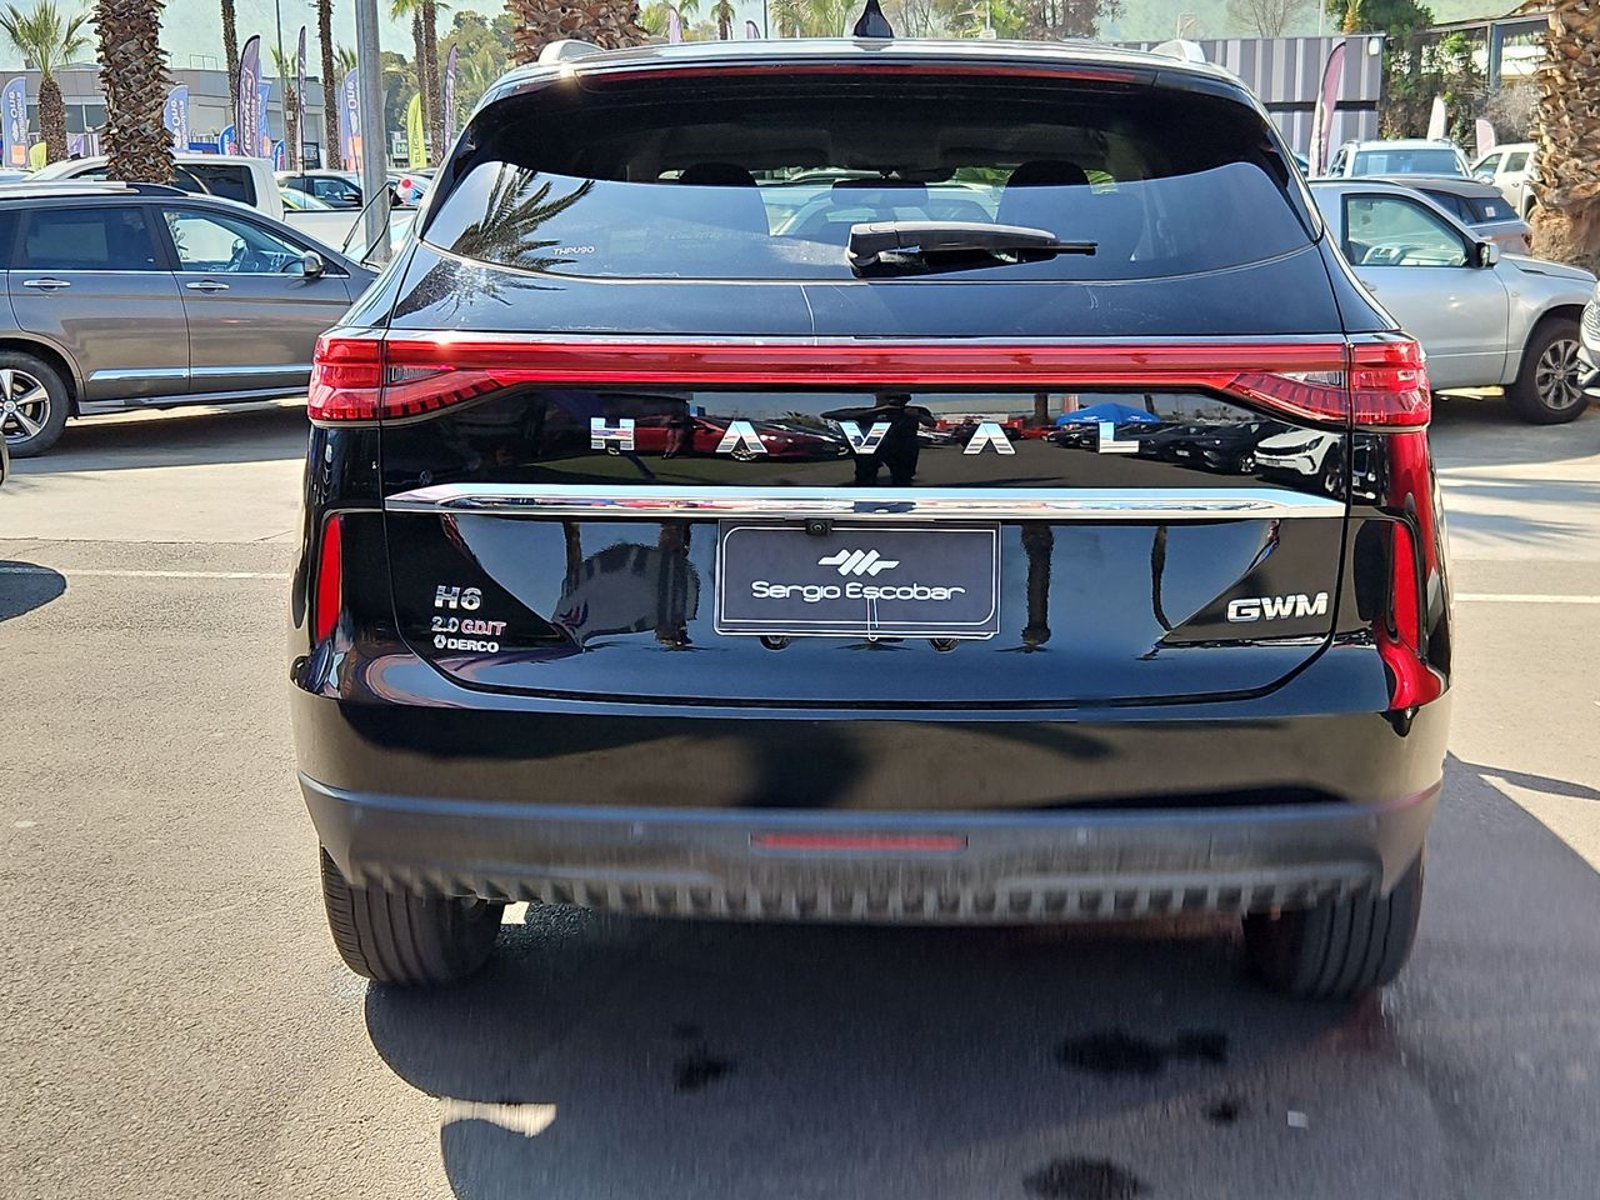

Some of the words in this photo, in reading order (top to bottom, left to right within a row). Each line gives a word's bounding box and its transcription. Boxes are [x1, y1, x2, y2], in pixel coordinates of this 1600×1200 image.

[590, 417, 1139, 456] HAVAL
[435, 585, 482, 611] H6
[752, 581, 841, 602] Sergio
[845, 582, 965, 600] Escobar
[1228, 592, 1329, 621] GWM
[431, 616, 459, 633] 2.0
[447, 638, 499, 653] DERCO
